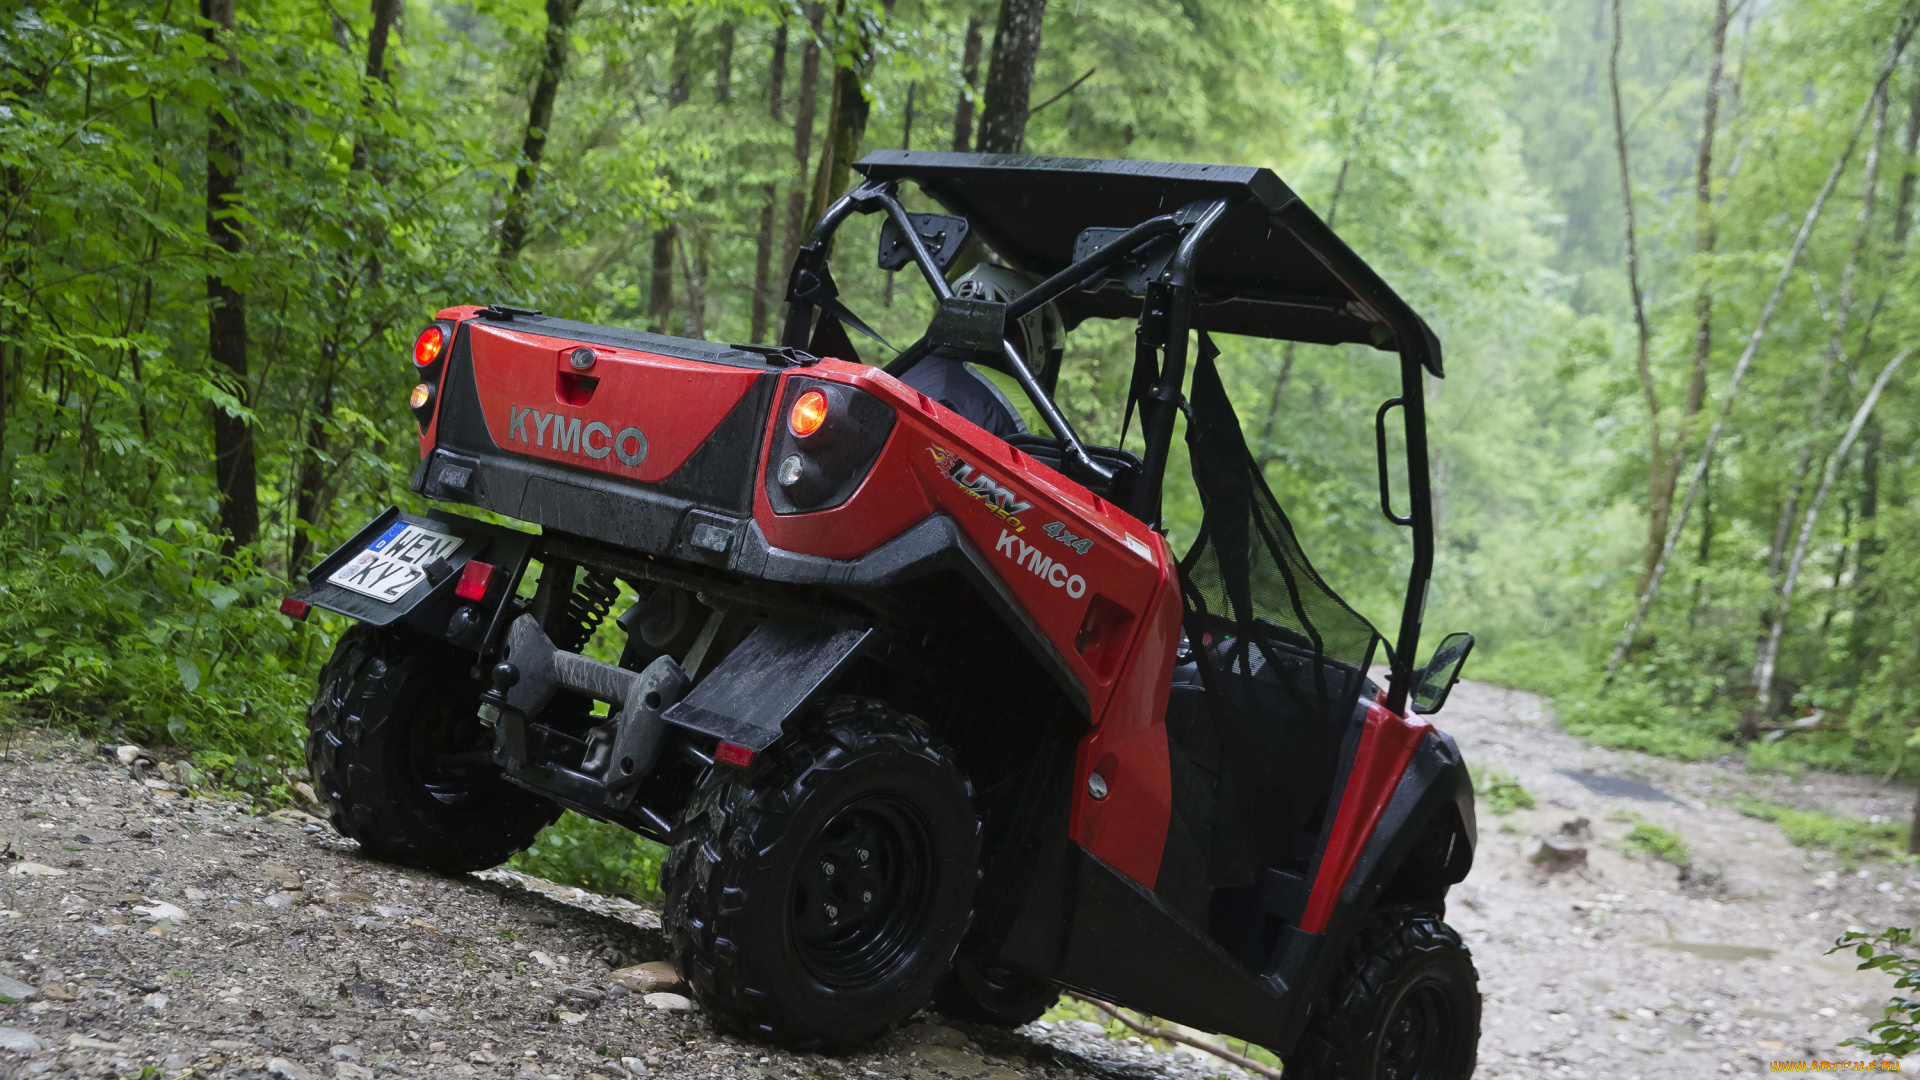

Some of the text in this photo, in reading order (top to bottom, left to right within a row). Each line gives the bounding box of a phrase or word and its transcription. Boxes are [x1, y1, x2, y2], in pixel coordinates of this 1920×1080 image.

[508, 404, 648, 467] KYMCO
[376, 539, 386, 549] D
[384, 530, 453, 564] WEN
[995, 528, 1086, 599] KYMCO
[349, 556, 422, 596] KY 2
